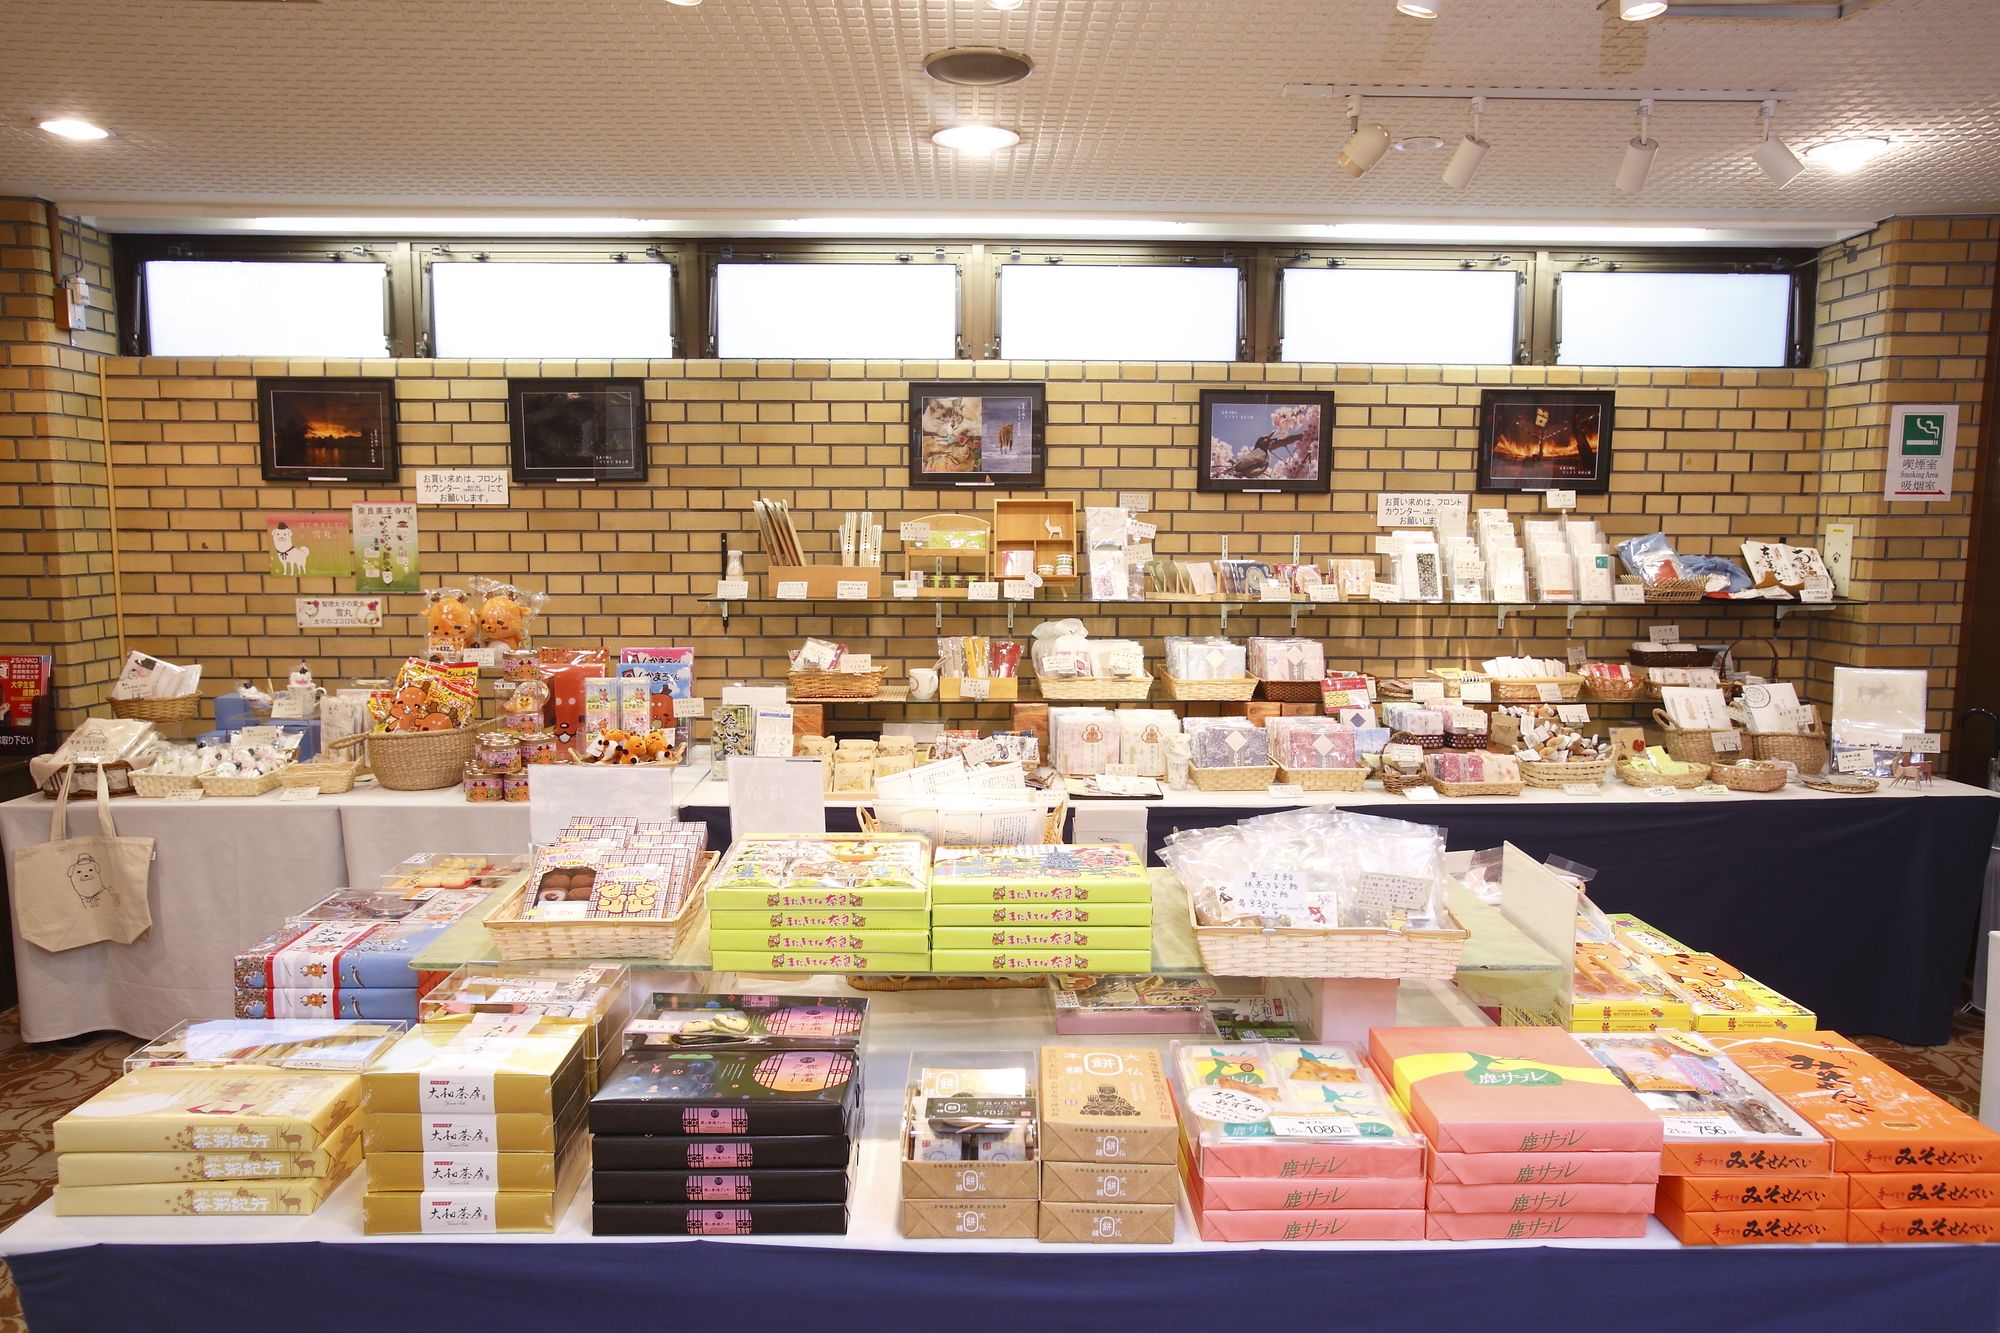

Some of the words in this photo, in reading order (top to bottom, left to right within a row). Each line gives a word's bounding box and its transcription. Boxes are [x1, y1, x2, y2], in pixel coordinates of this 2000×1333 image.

[1903, 459, 1937, 470] 喫煙室
[424, 474, 503, 483] お買い求めは、フロント
[1901, 481, 1936, 490] 吸烟室
[424, 484, 460, 492] カウンター
[488, 484, 502, 492] にて
[440, 494, 488, 502] お願いします。
[1384, 498, 1462, 506] お買い求めは、フロント
[357, 507, 412, 515] 奈良県王寺町
[1385, 507, 1420, 516] カウンター
[336, 608, 352, 616] 雪丸
[638, 672, 680, 681] しかまろくん
[1479, 1072, 1546, 1084] 鹿サブレ
[428, 1086, 480, 1099] 大和茶房
[193, 1134, 270, 1148] 茶粥紀行
[430, 1128, 483, 1141] 大和茶房
[1518, 1129, 1588, 1152] 鹿サブレ
[1726, 1150, 1812, 1169] みそせんべい
[1895, 1147, 1982, 1165] みそせんべい
[205, 1161, 284, 1177] 茶粥紀行
[432, 1166, 484, 1180] 大和茶房
[1280, 1156, 1347, 1177] 鹿サブレ
[1514, 1161, 1584, 1183] 鹿サブレ
[1283, 1186, 1350, 1208] 鹿サブレ
[1742, 1186, 1826, 1204] みそせんべい
[1908, 1182, 1992, 1202] みそせんべい
[193, 1198, 270, 1212] 茶粥紀行
[1510, 1191, 1579, 1212] 鹿サブレ
[429, 1206, 482, 1220] 大和茶房
[1282, 1218, 1350, 1240] 鹿サブレ
[1505, 1216, 1574, 1238] 鹿サブレ
[1742, 1220, 1826, 1238] みそせんべい
[1908, 1218, 1993, 1237] みそせんべい
